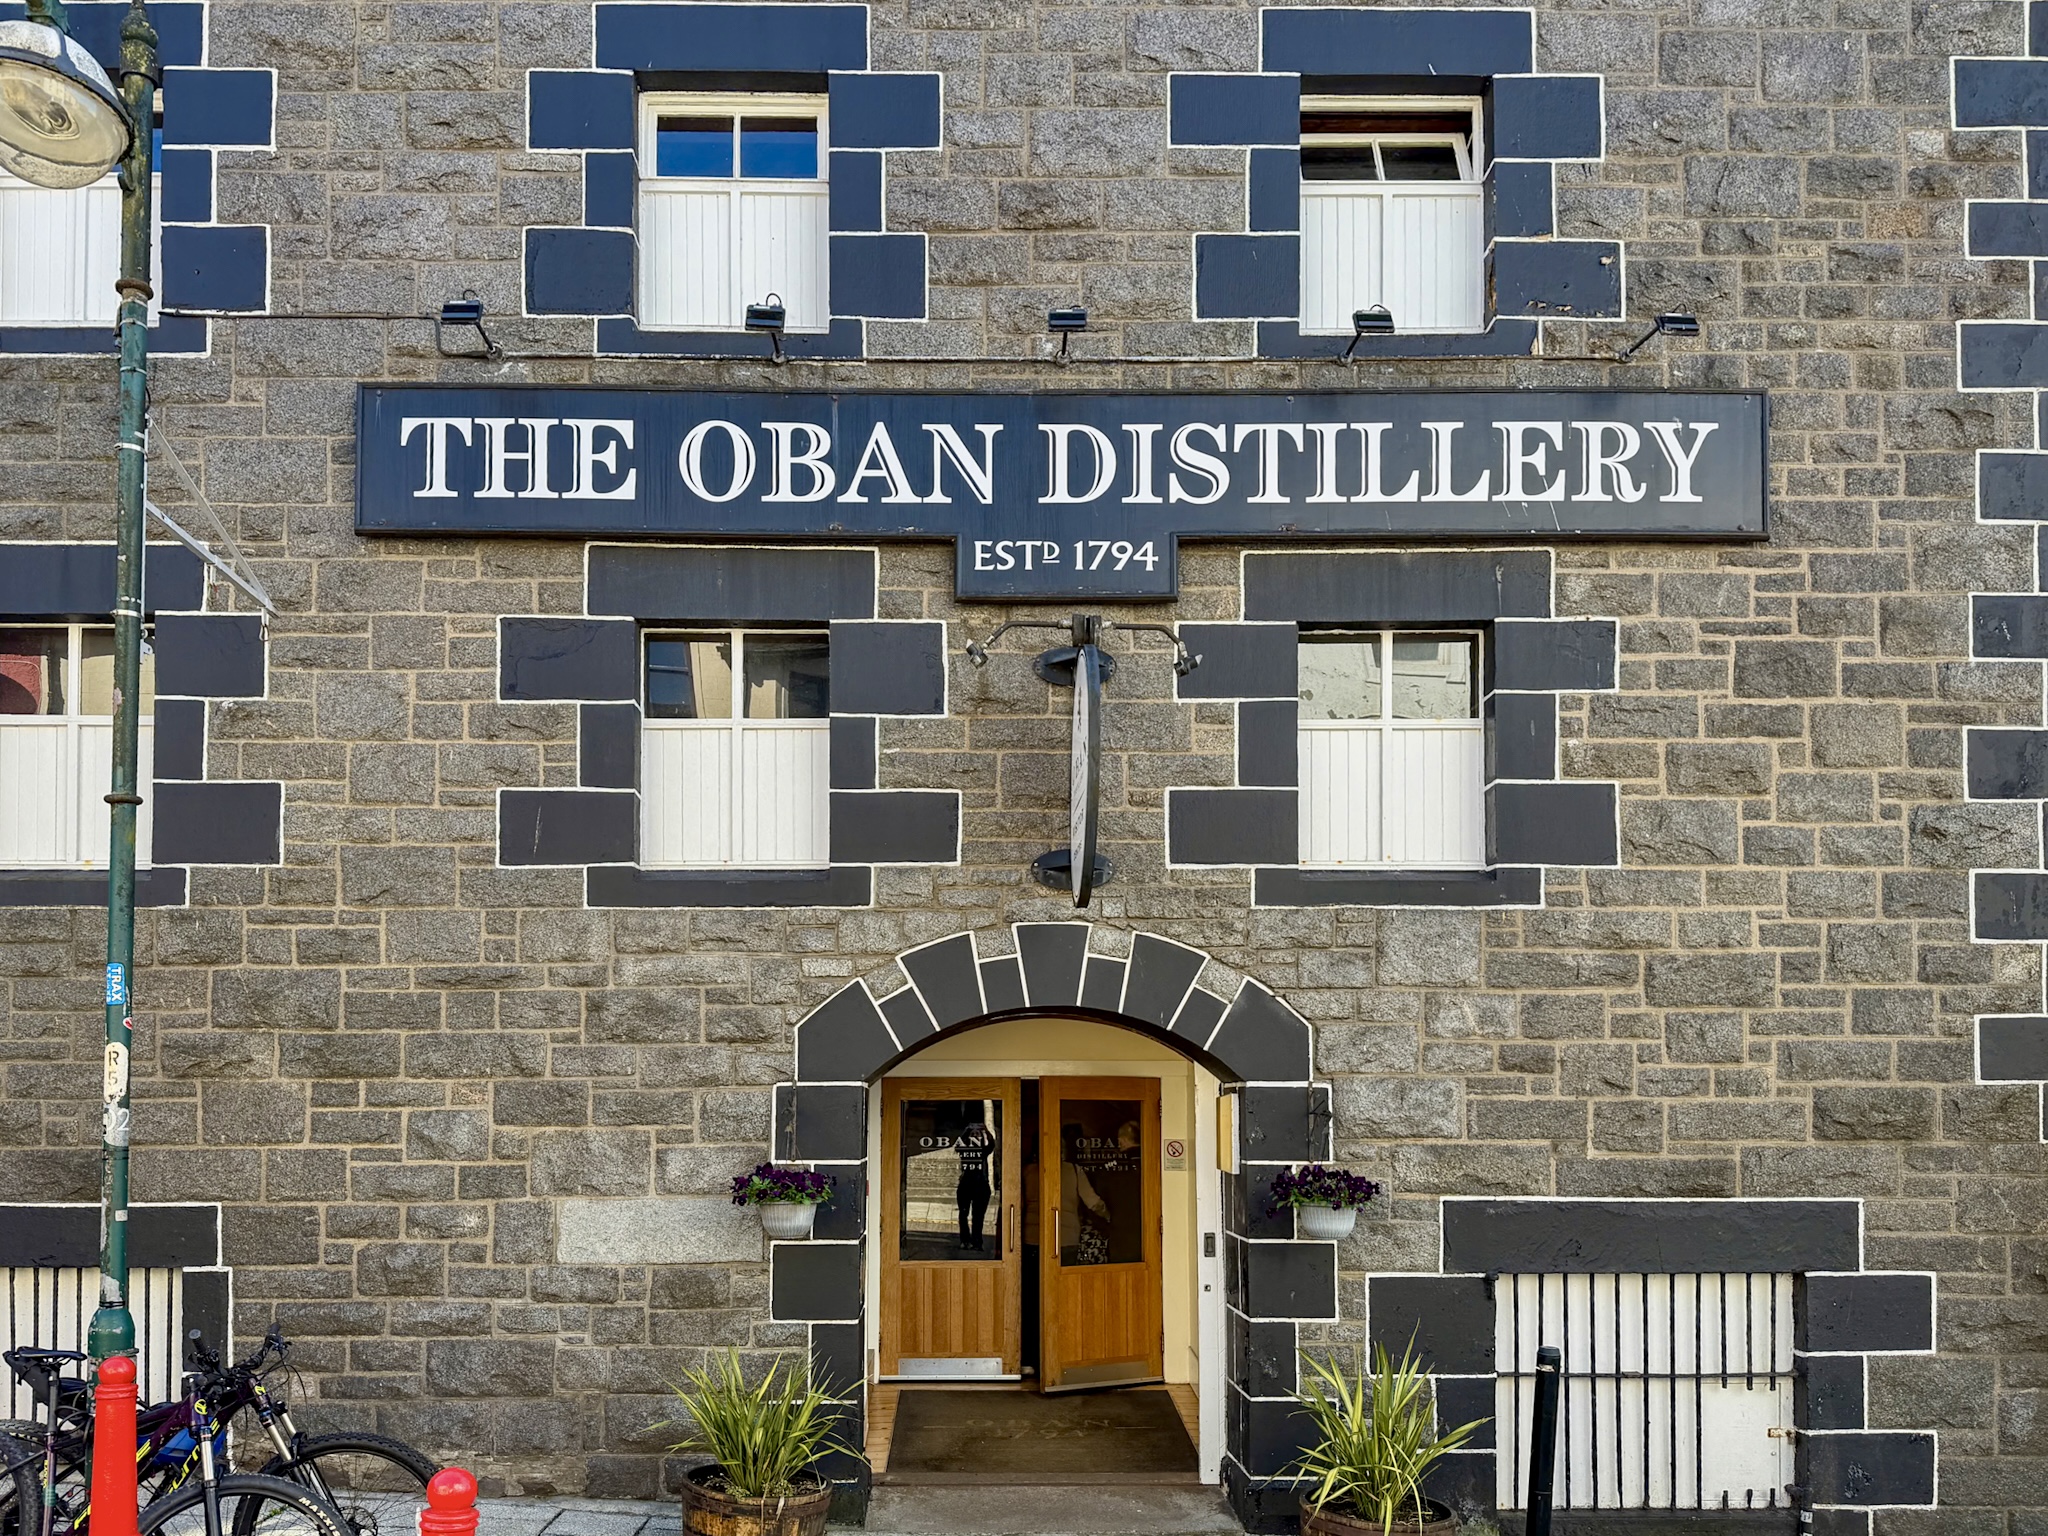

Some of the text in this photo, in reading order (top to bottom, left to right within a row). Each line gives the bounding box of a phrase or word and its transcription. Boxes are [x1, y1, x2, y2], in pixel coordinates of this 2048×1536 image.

[401, 418, 1720, 506] THE OBAN DISTILLERY
[1074, 540, 1160, 572] 1794
[111, 966, 123, 1002] TRAX
[108, 1050, 120, 1066] R
[919, 1136, 983, 1147] OBAN
[1075, 1137, 1122, 1149] OBA
[298, 1496, 342, 1536] MAXXIS
